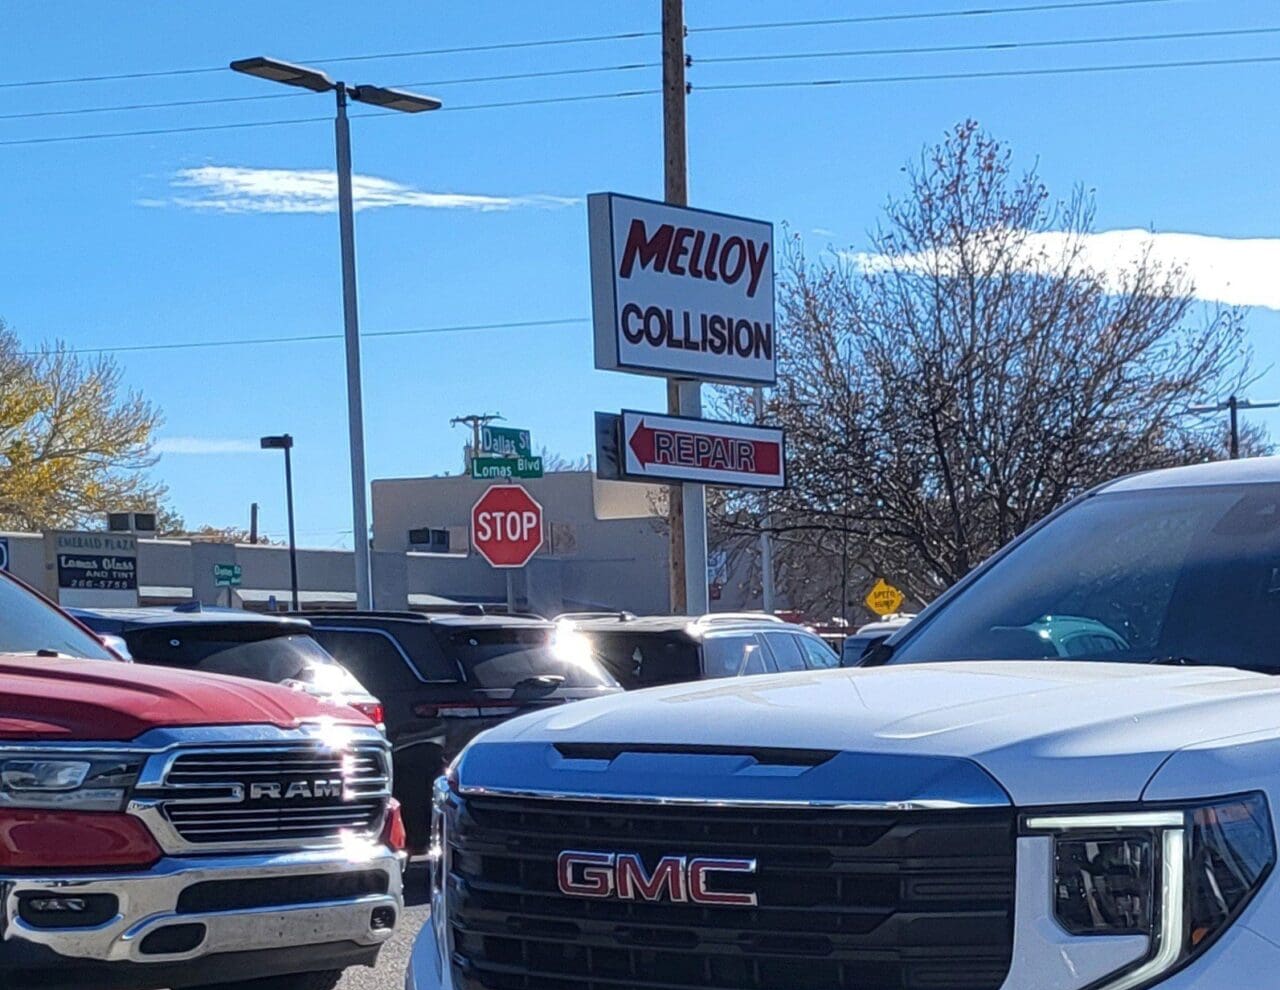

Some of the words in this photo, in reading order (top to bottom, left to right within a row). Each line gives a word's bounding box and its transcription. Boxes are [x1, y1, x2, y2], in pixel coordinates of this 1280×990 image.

[621, 303, 772, 360] COLLISION
[483, 428, 516, 455] Dallas
[519, 431, 530, 450] St
[654, 431, 756, 472] REPAIR
[473, 459, 513, 477] Lomas
[517, 458, 540, 471] Blvd
[477, 511, 537, 541] STOP
[61, 555, 98, 569] Lomas
[102, 558, 134, 570] Glass
[85, 570, 109, 578] AND
[112, 571, 135, 579] TINT
[249, 780, 341, 799] RAM
[557, 850, 758, 906] GMC
